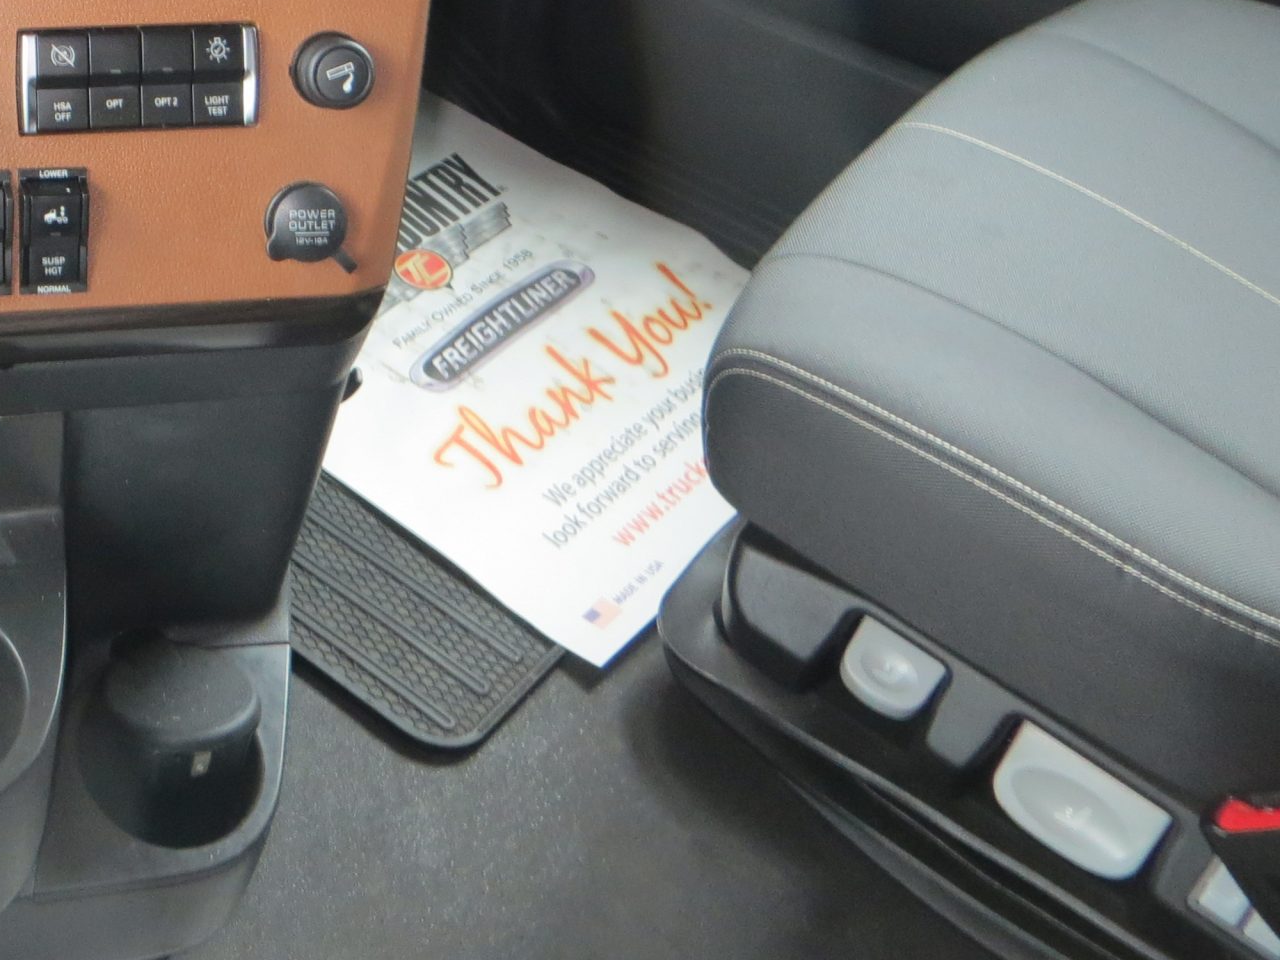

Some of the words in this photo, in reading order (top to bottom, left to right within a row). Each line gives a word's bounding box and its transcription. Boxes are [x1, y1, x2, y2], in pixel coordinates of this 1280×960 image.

[106, 98, 124, 109] OPT
[154, 97, 172, 108] OPT
[204, 94, 230, 106] LIGHT
[53, 101, 71, 112] HSA
[207, 105, 228, 117] TEST
[54, 112, 71, 122] OFF
[39, 169, 69, 179] LOWER
[289, 208, 336, 220] POWER
[288, 220, 336, 232] OUTLET
[41, 256, 66, 266] SUSP
[44, 265, 63, 276] HGT
[36, 284, 72, 295] NORMAL
[431, 269, 577, 381] FREIGHTLINER
[433, 344, 616, 490] Thank
[586, 261, 714, 379] You!
[543, 481, 577, 509] We
[572, 421, 648, 490] appreciate
[642, 396, 677, 431] your
[542, 514, 588, 550] look
[576, 464, 642, 522] forward
[633, 452, 658, 473] to
